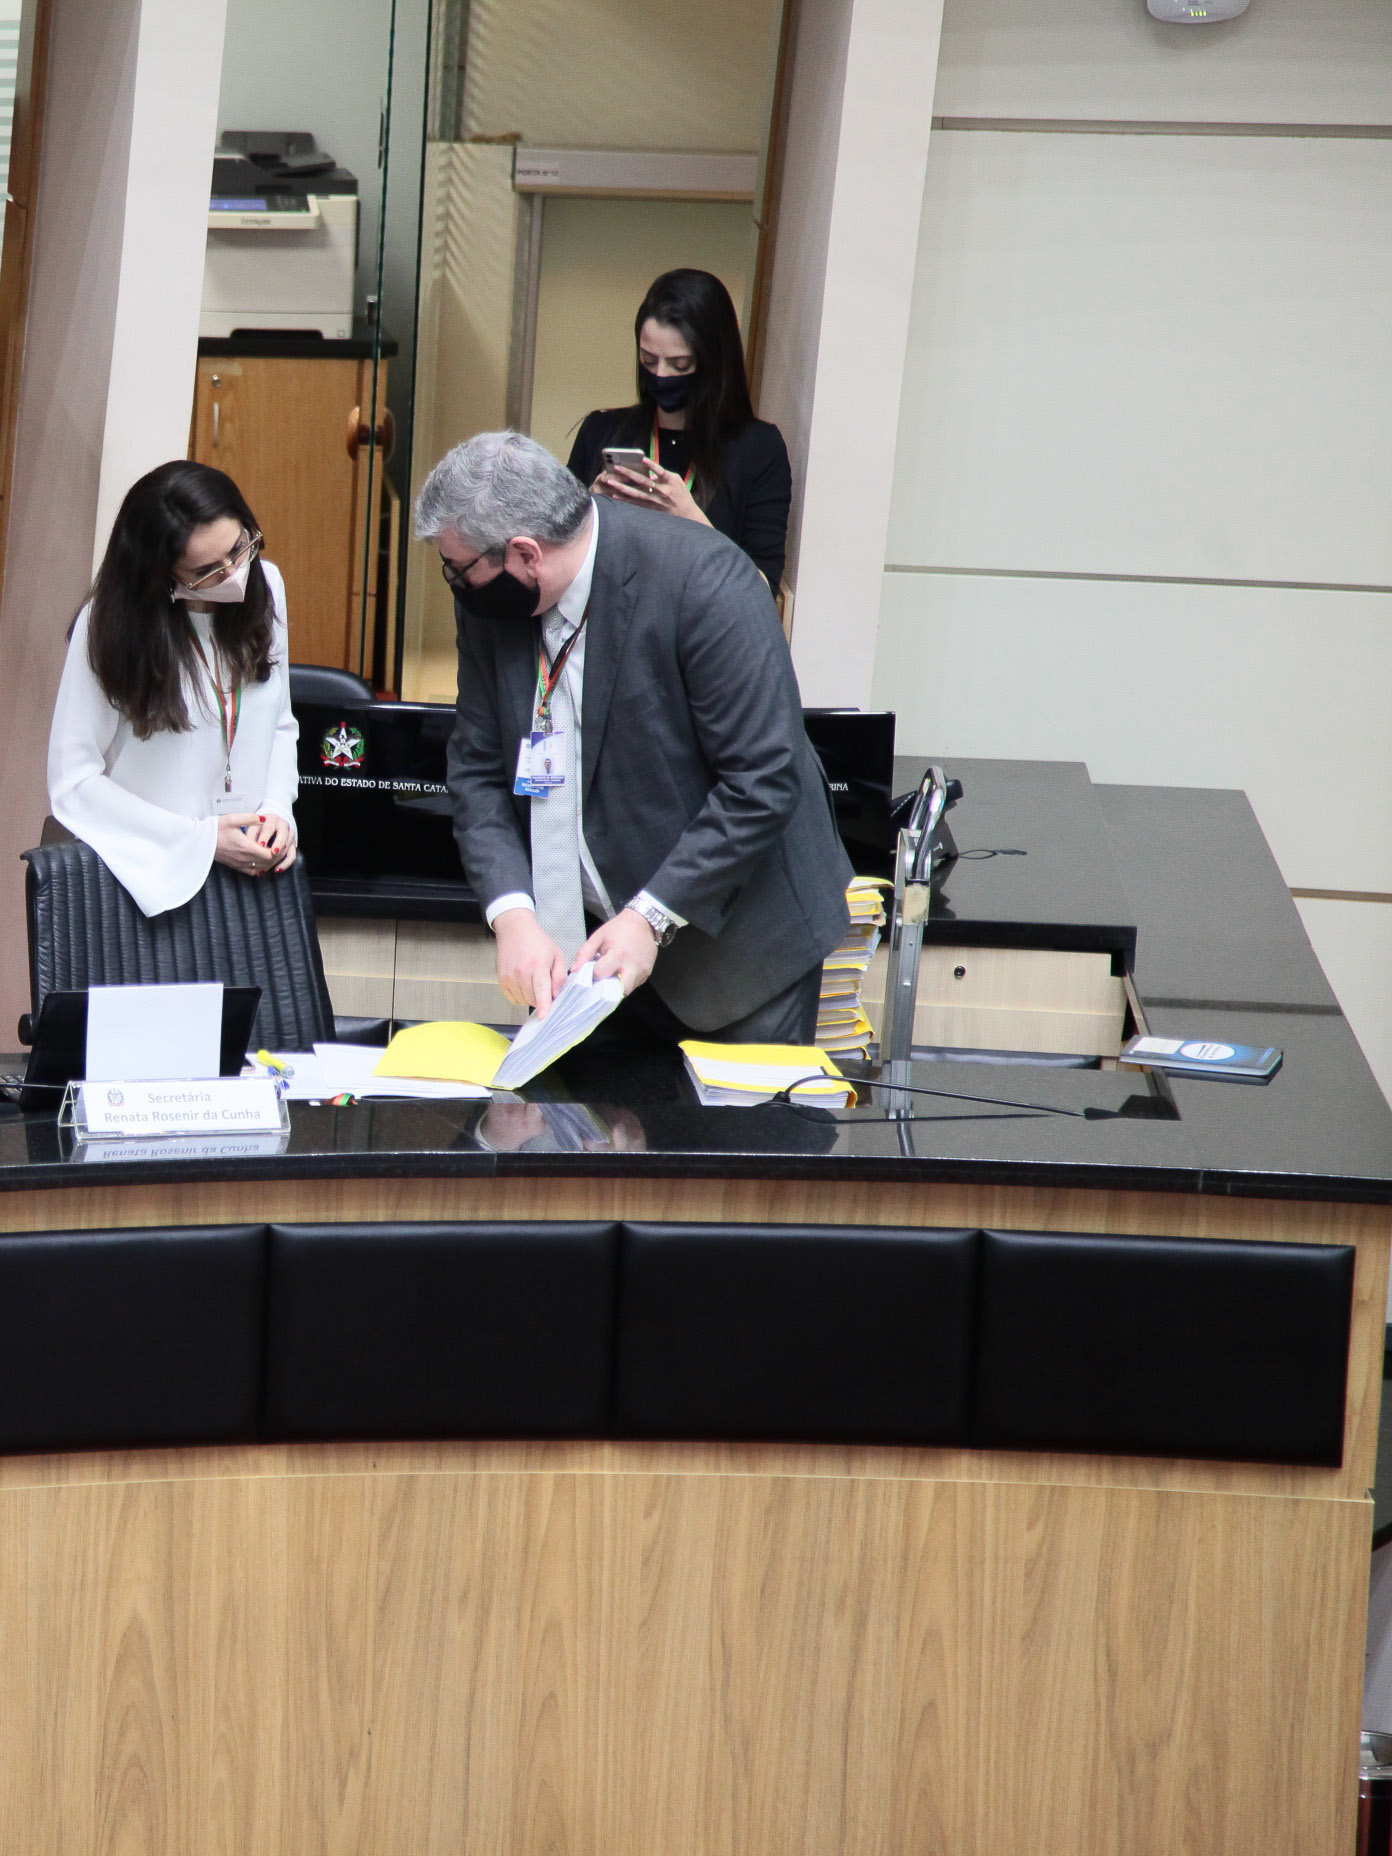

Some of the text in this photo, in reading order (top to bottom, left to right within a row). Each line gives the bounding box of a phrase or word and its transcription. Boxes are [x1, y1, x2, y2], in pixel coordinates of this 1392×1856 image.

[325, 777, 338, 786] DO
[340, 778, 376, 788] ESTADO
[378, 780, 391, 790] DE
[392, 781, 422, 792] SANTA
[147, 1091, 212, 1104] Secretária
[104, 1108, 261, 1123] Renata Rosenir da Cunha
